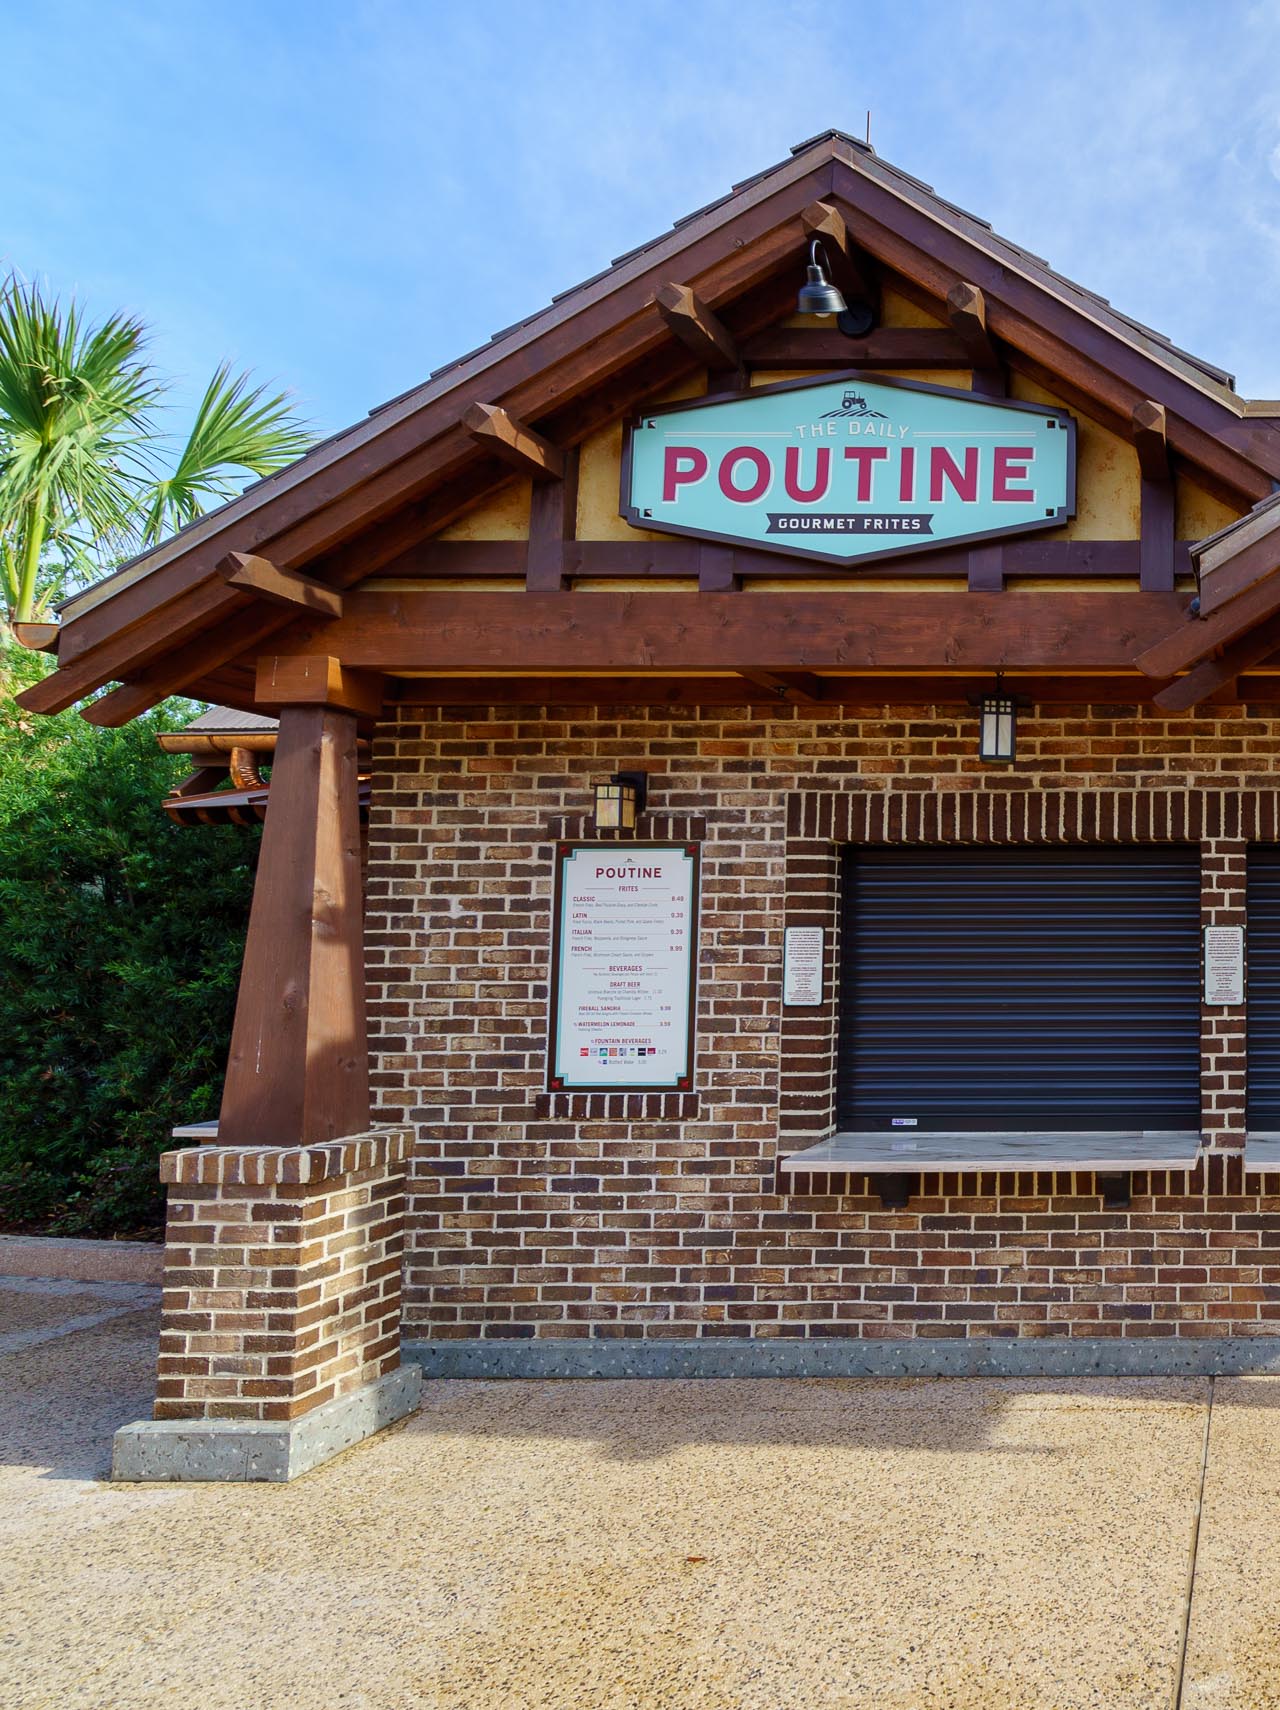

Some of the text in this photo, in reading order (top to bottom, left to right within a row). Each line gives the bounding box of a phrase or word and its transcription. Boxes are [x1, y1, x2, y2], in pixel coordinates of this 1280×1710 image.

[796, 421, 910, 440] THE DAILY
[661, 445, 1037, 505] POUTINE
[777, 518, 922, 530] GOURMET FRITES
[596, 868, 662, 878] POUTINE
